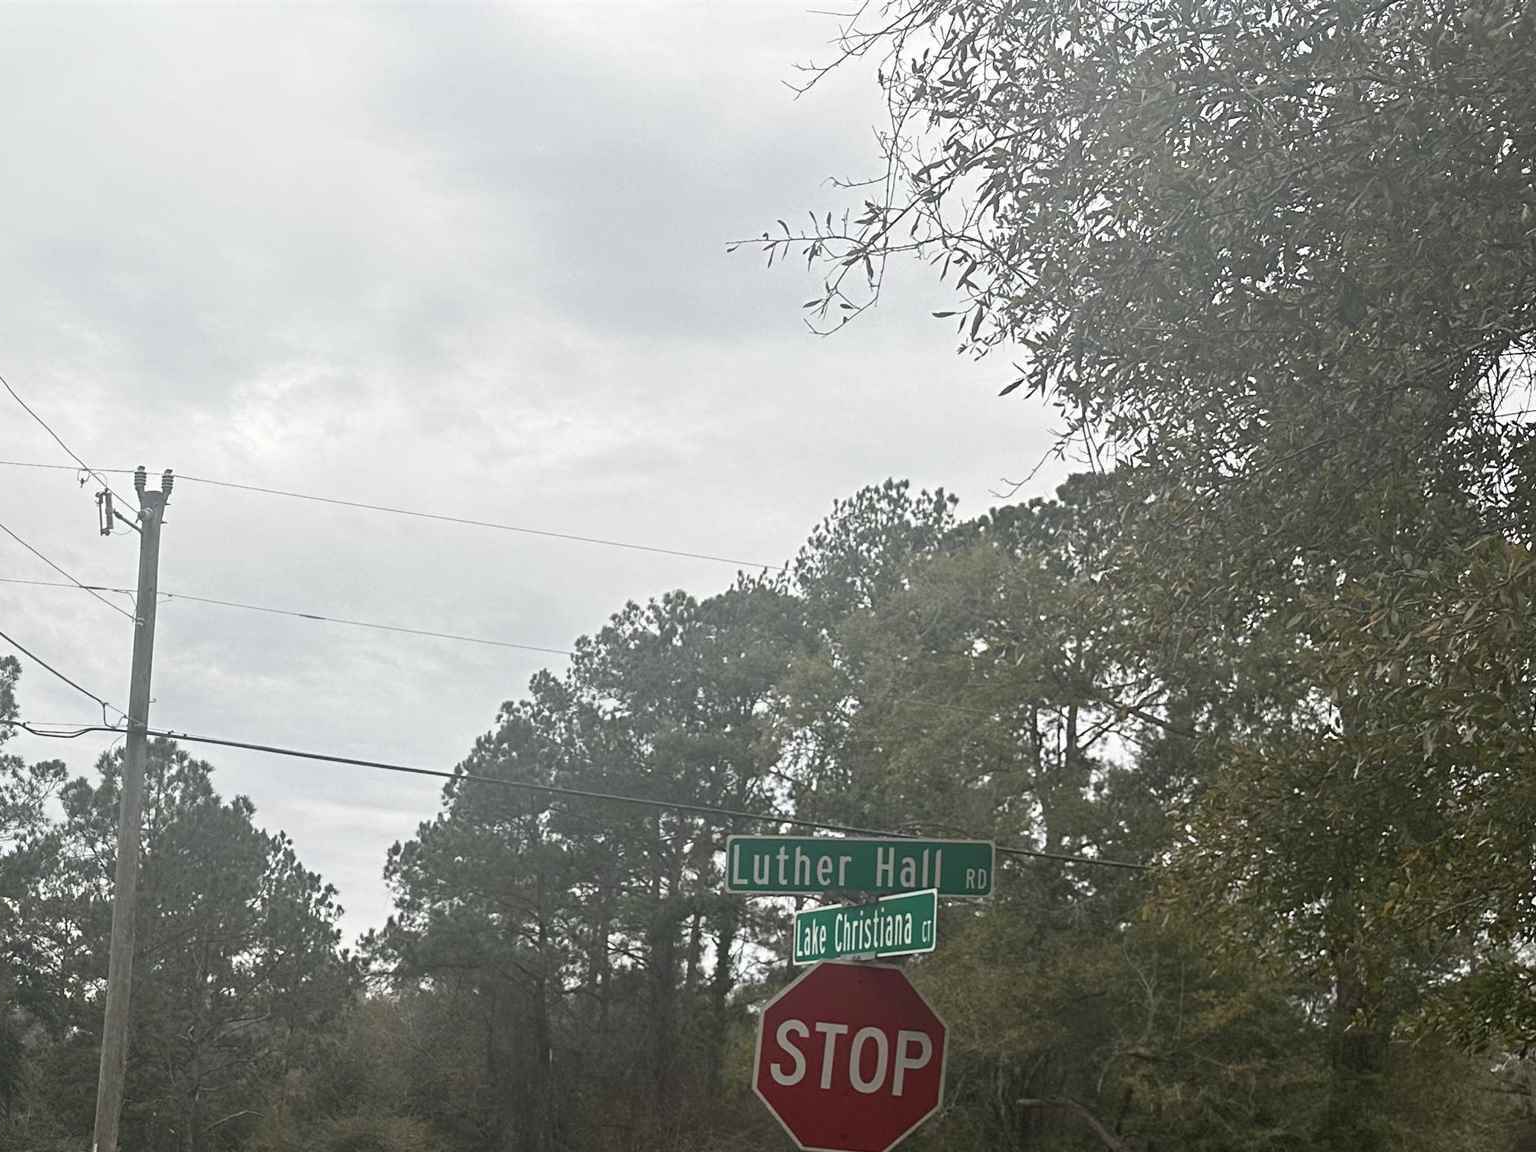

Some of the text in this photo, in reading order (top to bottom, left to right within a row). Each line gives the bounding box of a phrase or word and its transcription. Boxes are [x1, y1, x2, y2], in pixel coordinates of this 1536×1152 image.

[732, 844, 987, 890] Luther Hall RD
[796, 907, 932, 957] Lake Christiana CT
[770, 1018, 933, 1097] STOP
